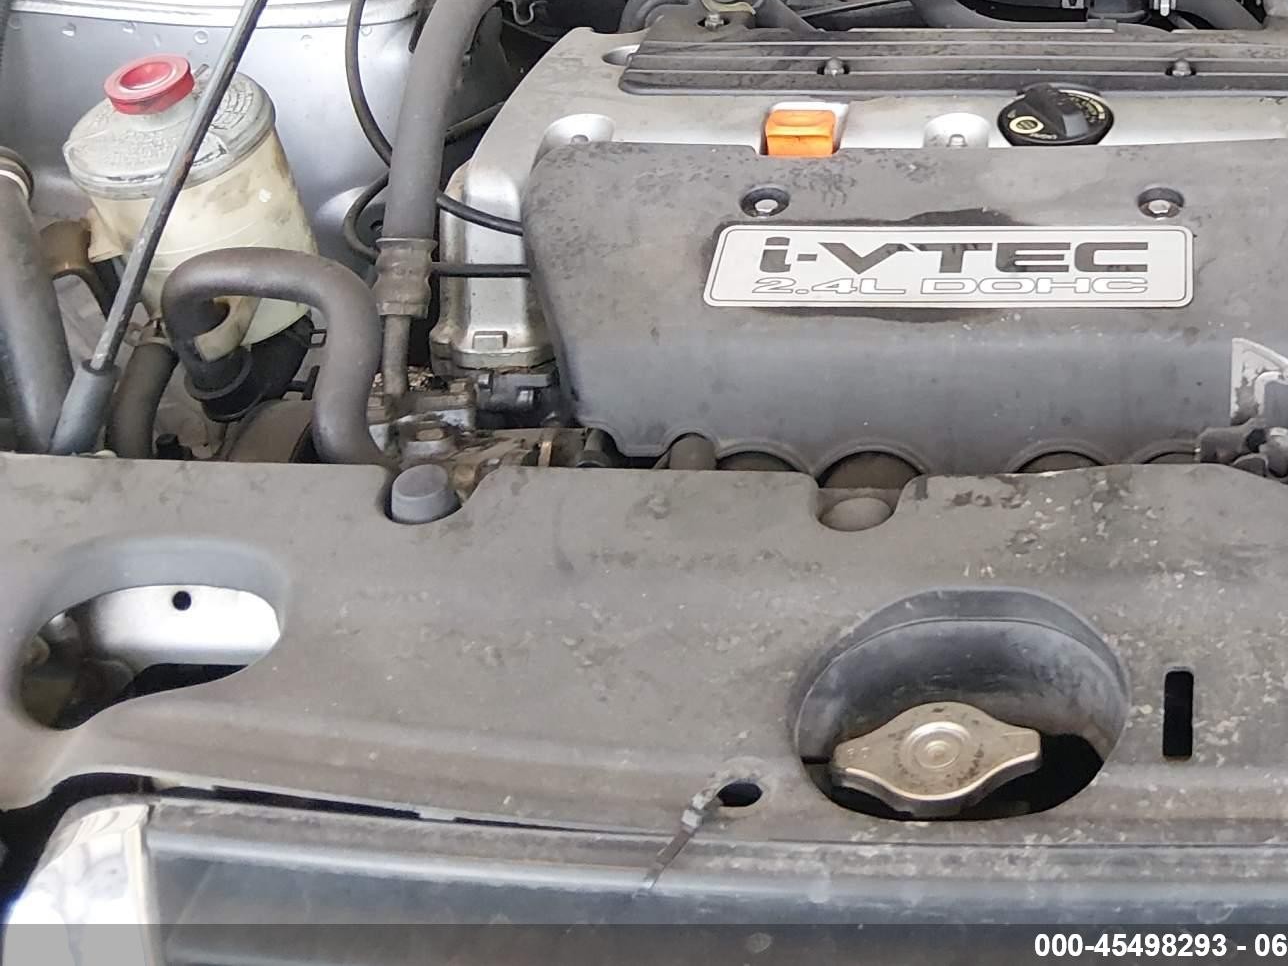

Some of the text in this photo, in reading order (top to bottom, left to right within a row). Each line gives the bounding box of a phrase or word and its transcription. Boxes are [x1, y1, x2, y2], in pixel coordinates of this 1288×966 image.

[759, 236, 1149, 274] i-VTEC
[752, 277, 1149, 295] 2.4L DOHC
